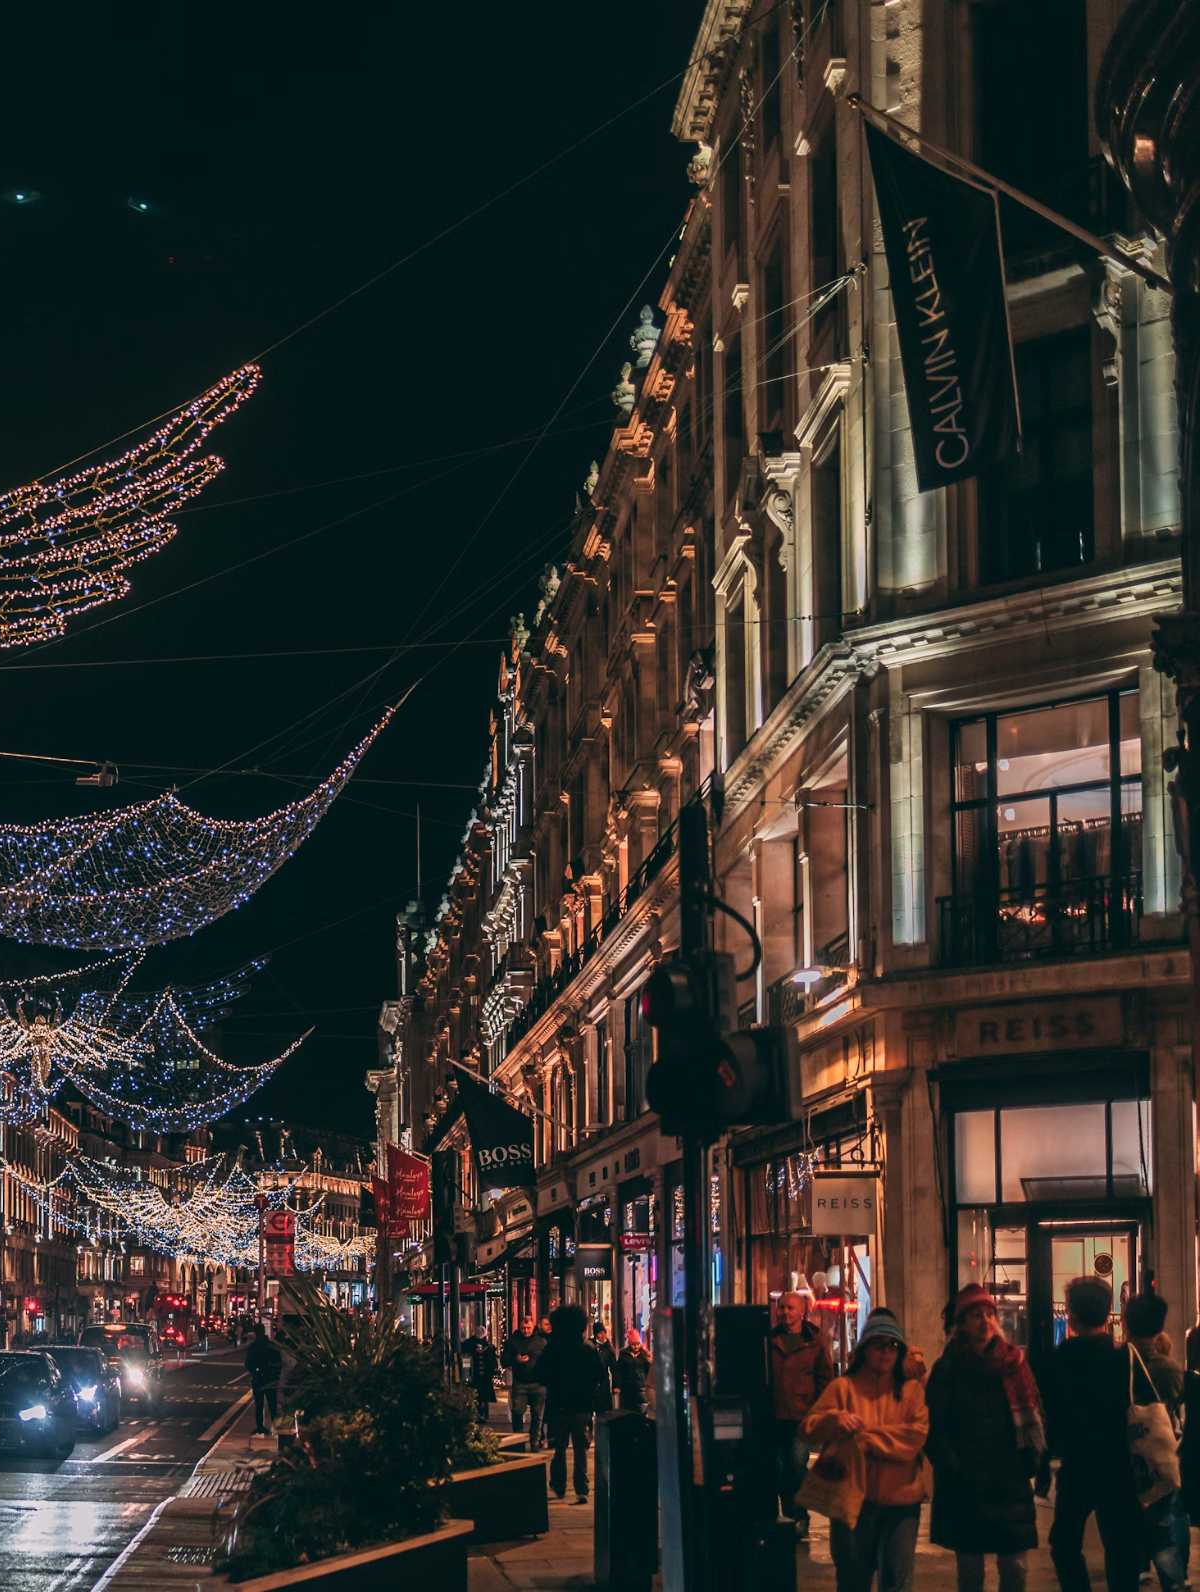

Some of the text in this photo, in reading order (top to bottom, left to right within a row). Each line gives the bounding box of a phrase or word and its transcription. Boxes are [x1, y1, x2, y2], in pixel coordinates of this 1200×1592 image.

[902, 217, 969, 468] CALVIN KLEIN
[979, 1012, 1095, 1044] REISS
[478, 1143, 532, 1166] BOSS
[395, 1168, 423, 1182] Hamleys
[395, 1185, 424, 1200] Hamleys
[395, 1203, 424, 1218] Hamleys
[817, 1198, 872, 1209] REISS
[584, 1267, 605, 1275] BOSS
